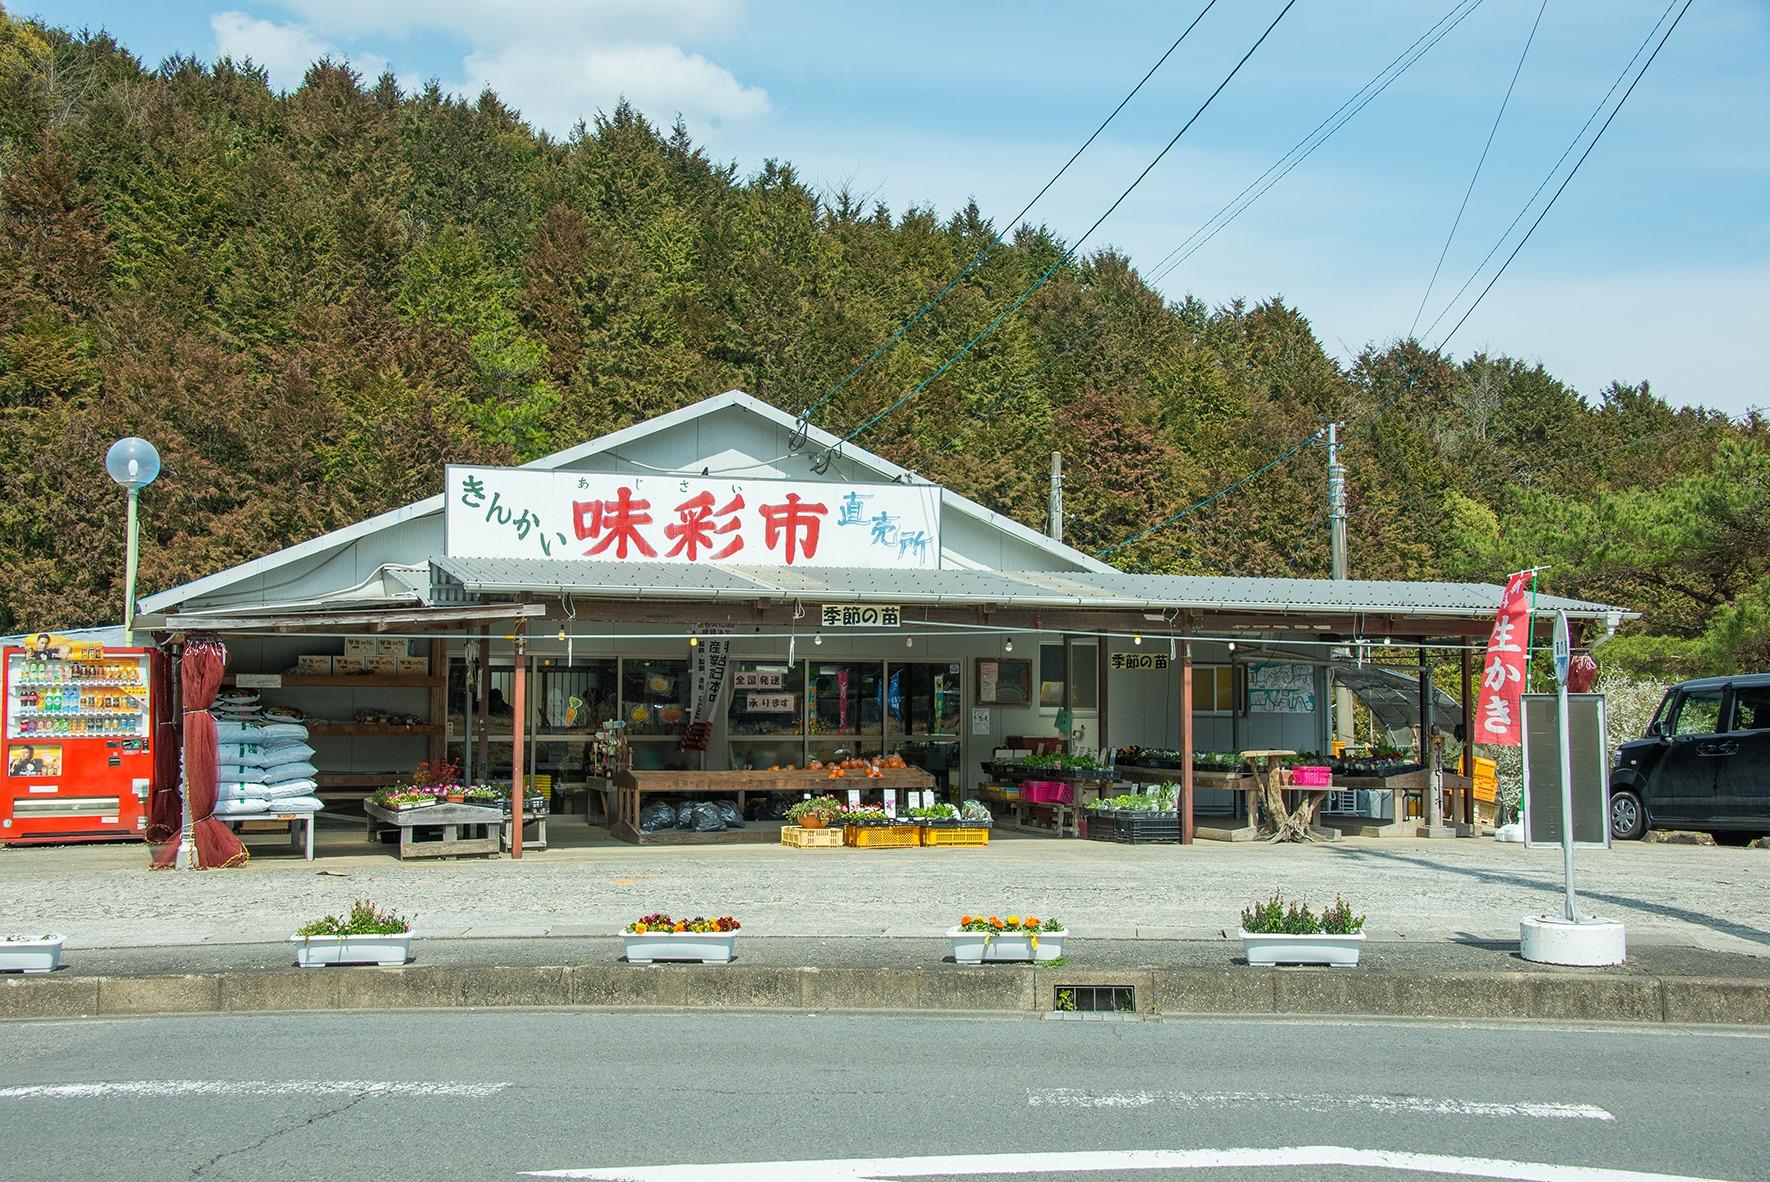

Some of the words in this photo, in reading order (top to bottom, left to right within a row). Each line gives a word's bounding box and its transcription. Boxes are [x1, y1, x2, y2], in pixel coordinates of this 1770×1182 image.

[577, 477, 743, 494] あじさい
[461, 475, 567, 557] きんかい
[572, 486, 829, 565] 味彩市
[837, 491, 935, 566] 直売所
[823, 606, 899, 625] 季節の苗
[1111, 653, 1168, 669] 季節の苗
[735, 674, 781, 687] 全国発送
[1484, 614, 1522, 734] 生かき
[748, 697, 790, 709] 承ります
